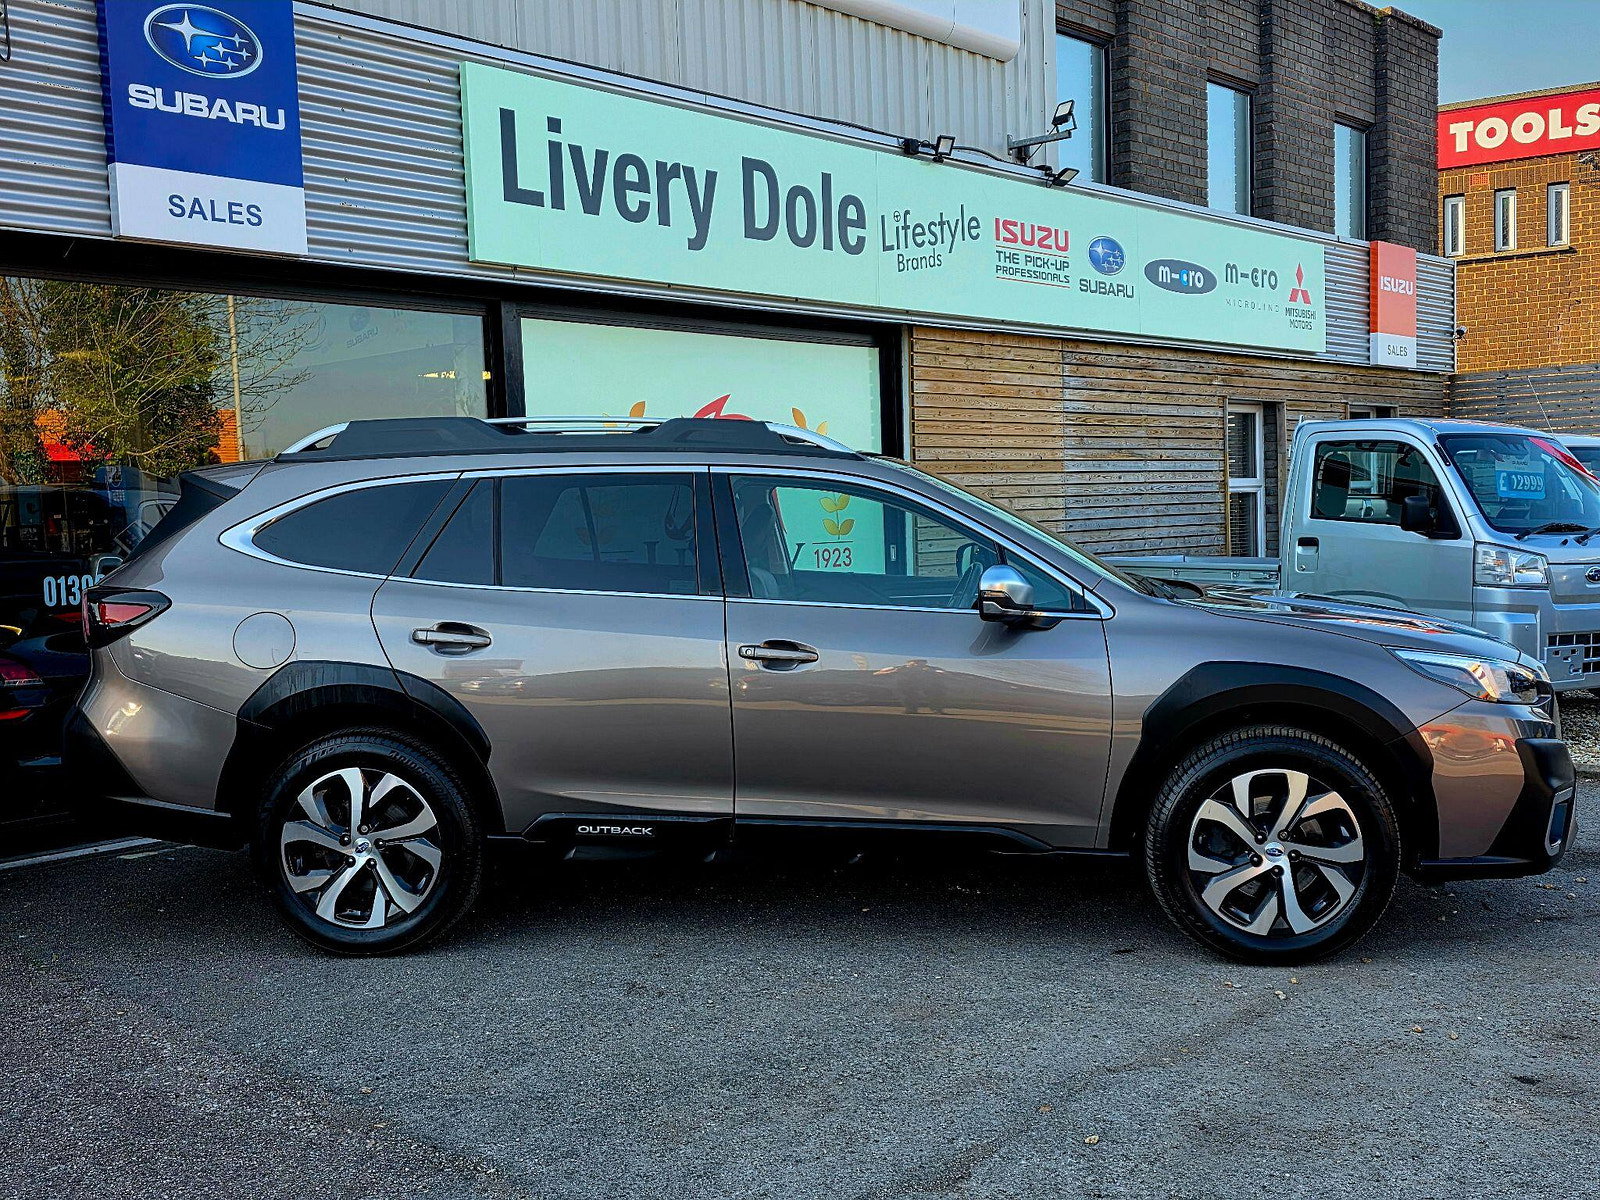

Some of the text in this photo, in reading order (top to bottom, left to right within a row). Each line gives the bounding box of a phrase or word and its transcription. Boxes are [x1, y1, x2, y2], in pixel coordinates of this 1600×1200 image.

[128, 83, 286, 131] SUBARU
[1450, 103, 1600, 153] TOOLS
[499, 106, 867, 256] Livery Dole
[168, 194, 263, 227] SALES
[880, 204, 981, 253] Lifestyle
[994, 217, 1070, 252] ISUZU
[897, 248, 942, 272] Brands
[995, 250, 1070, 271] THE PICK-UP
[995, 265, 1070, 284] PROFESSIONALS
[1380, 275, 1414, 295] ISUZU
[1079, 279, 1135, 298] SUBARU
[1285, 307, 1316, 320] MITSUBISHI
[1289, 319, 1313, 330] MOTORS
[1387, 344, 1408, 357] SALES
[1511, 474, 1544, 491] 12999
[813, 547, 853, 569] 1923
[577, 825, 653, 836] OUTBACK
